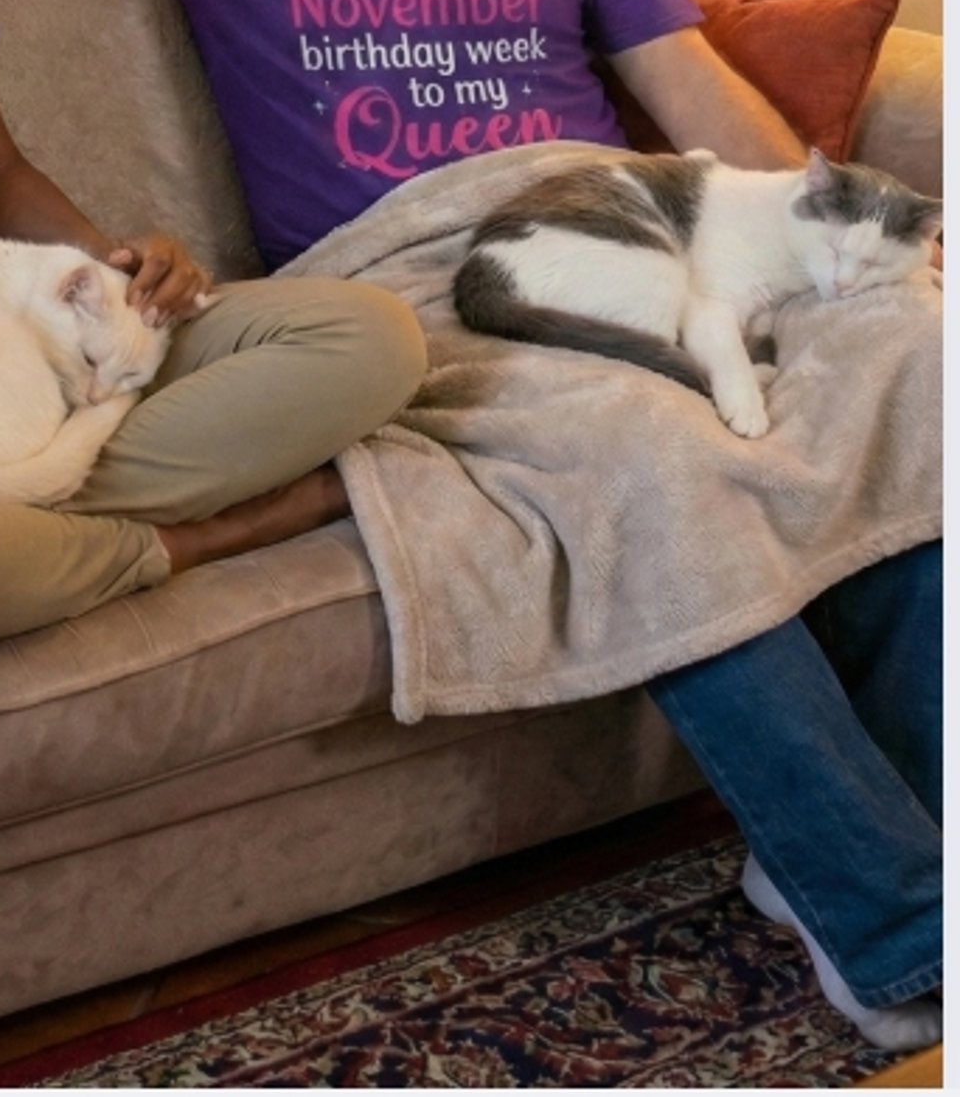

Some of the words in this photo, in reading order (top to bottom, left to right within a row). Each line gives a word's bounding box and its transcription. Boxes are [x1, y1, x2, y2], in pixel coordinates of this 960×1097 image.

[300, 33, 456, 76] birthday
[465, 27, 547, 65] week
[409, 77, 444, 108] to
[455, 78, 508, 110] my
[334, 85, 562, 178] Queen
